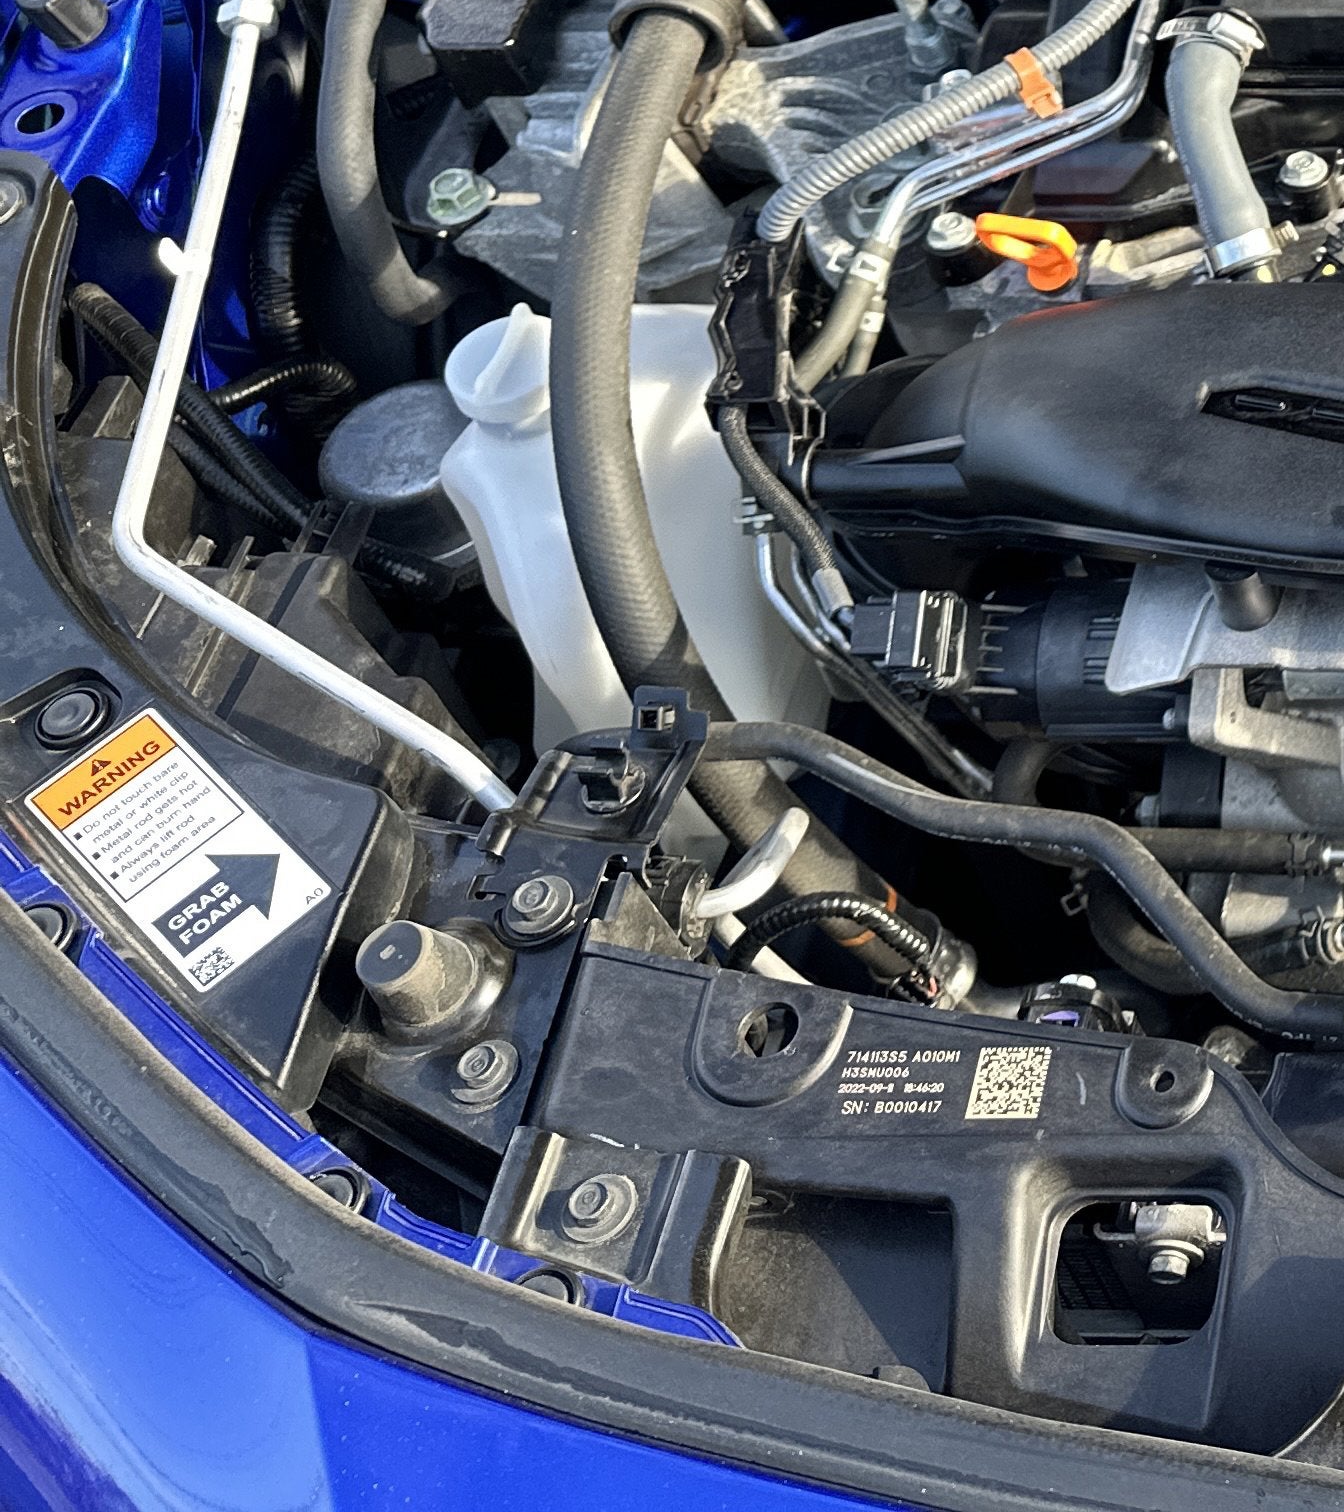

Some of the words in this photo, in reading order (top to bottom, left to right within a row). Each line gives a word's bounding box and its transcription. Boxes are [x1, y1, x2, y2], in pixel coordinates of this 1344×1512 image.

[57, 740, 161, 816] WARNING
[83, 820, 101, 834] Do
[102, 804, 121, 821] not
[120, 781, 152, 806] touch
[152, 762, 179, 782] bare
[93, 818, 124, 843] metal
[125, 809, 137, 820] or
[139, 788, 168, 810] white
[169, 771, 189, 788] clip
[102, 827, 133, 854] Metal
[134, 814, 153, 830] rod
[154, 796, 178, 815] gets
[179, 780, 198, 796] hot
[110, 845, 133, 863] and
[134, 829, 156, 846] can
[182, 786, 212, 809] hand
[120, 843, 160, 873] Always
[161, 829, 175, 843] lift
[175, 814, 196, 832] rod
[129, 858, 161, 883] using
[160, 837, 190, 859] foam
[190, 816, 216, 837] area
[168, 881, 230, 930] GRAB
[178, 893, 242, 945] FOAM
[841, 1066, 910, 1078] H3SMU006
[847, 1050, 908, 1063] 714113S5
[911, 1050, 961, 1063] A010M1
[841, 1100, 870, 1115] SN:
[874, 1100, 942, 1114] B0010417
